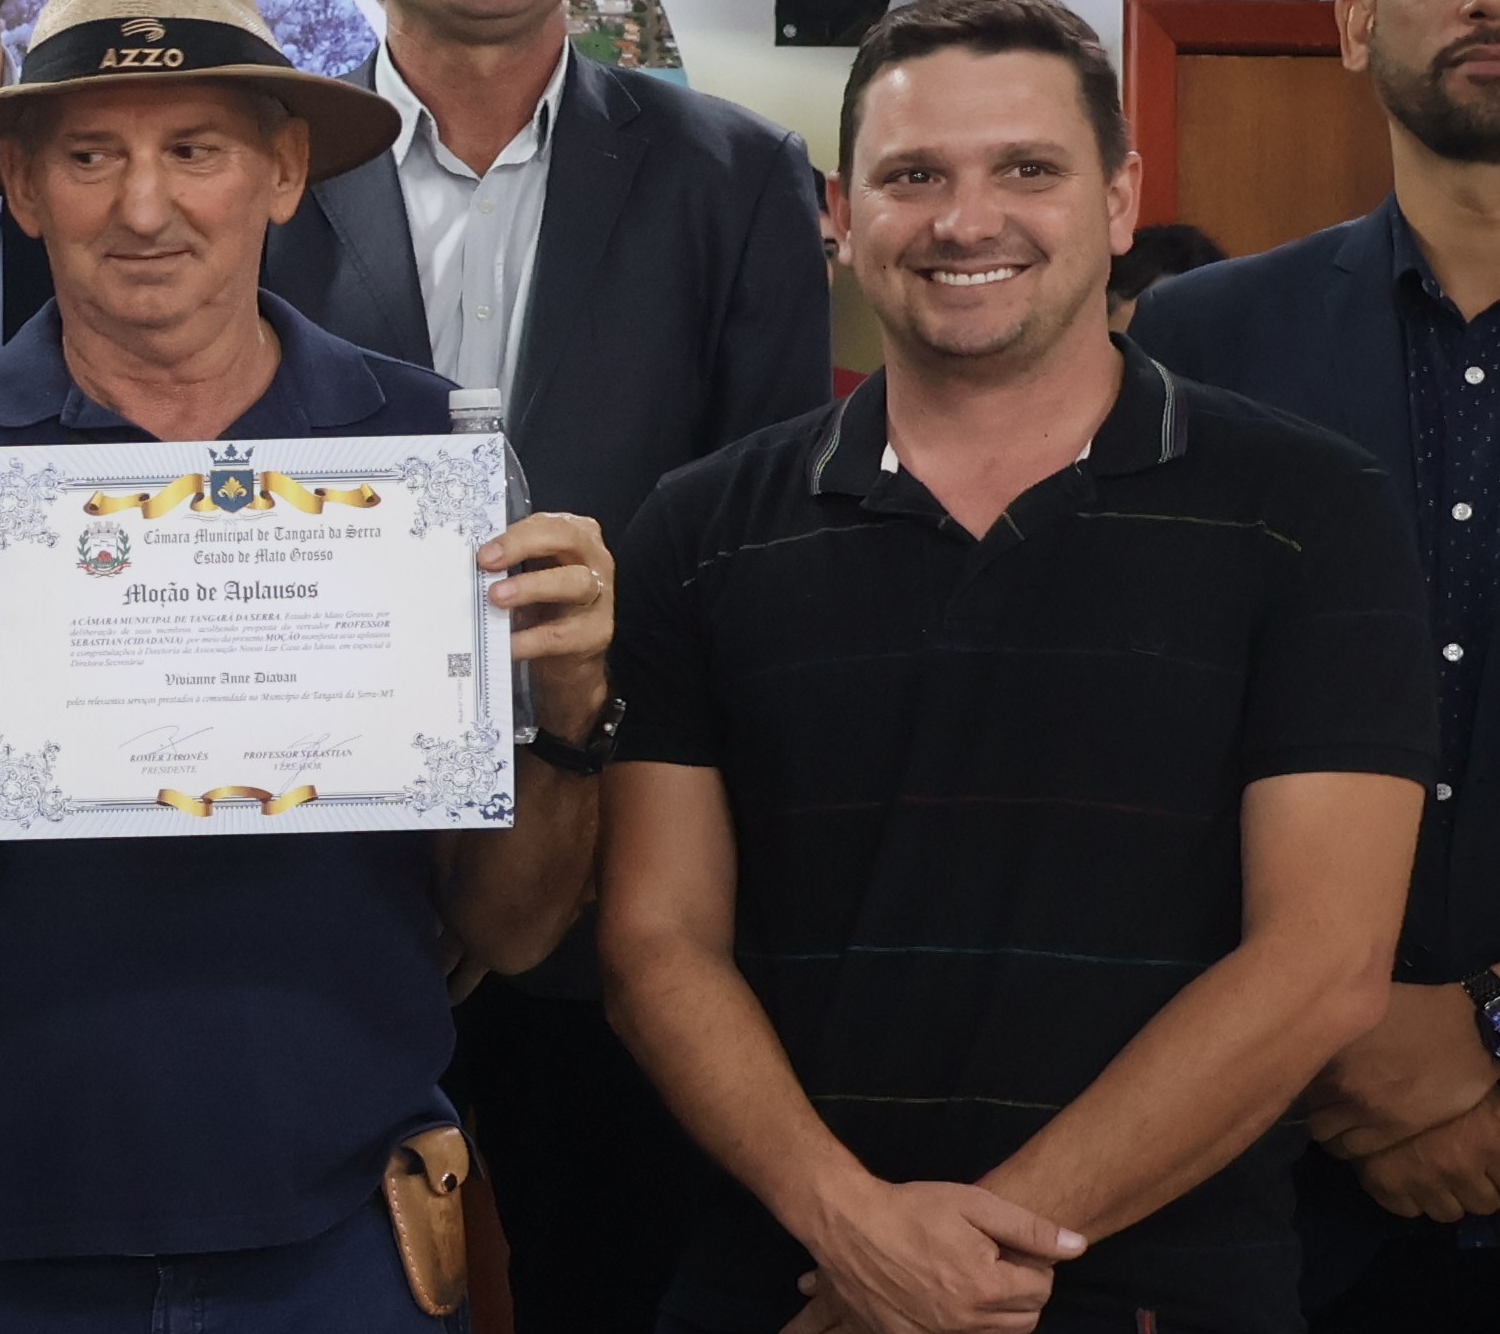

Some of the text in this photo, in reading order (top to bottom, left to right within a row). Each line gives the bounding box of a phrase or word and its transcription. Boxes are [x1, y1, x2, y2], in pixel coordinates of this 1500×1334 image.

[100, 48, 185, 69] AZZO
[144, 525, 380, 544] Câmara Municipal de Tangará da Serra
[123, 581, 318, 607] Moção de Aplausos
[221, 672, 250, 684] Anne
